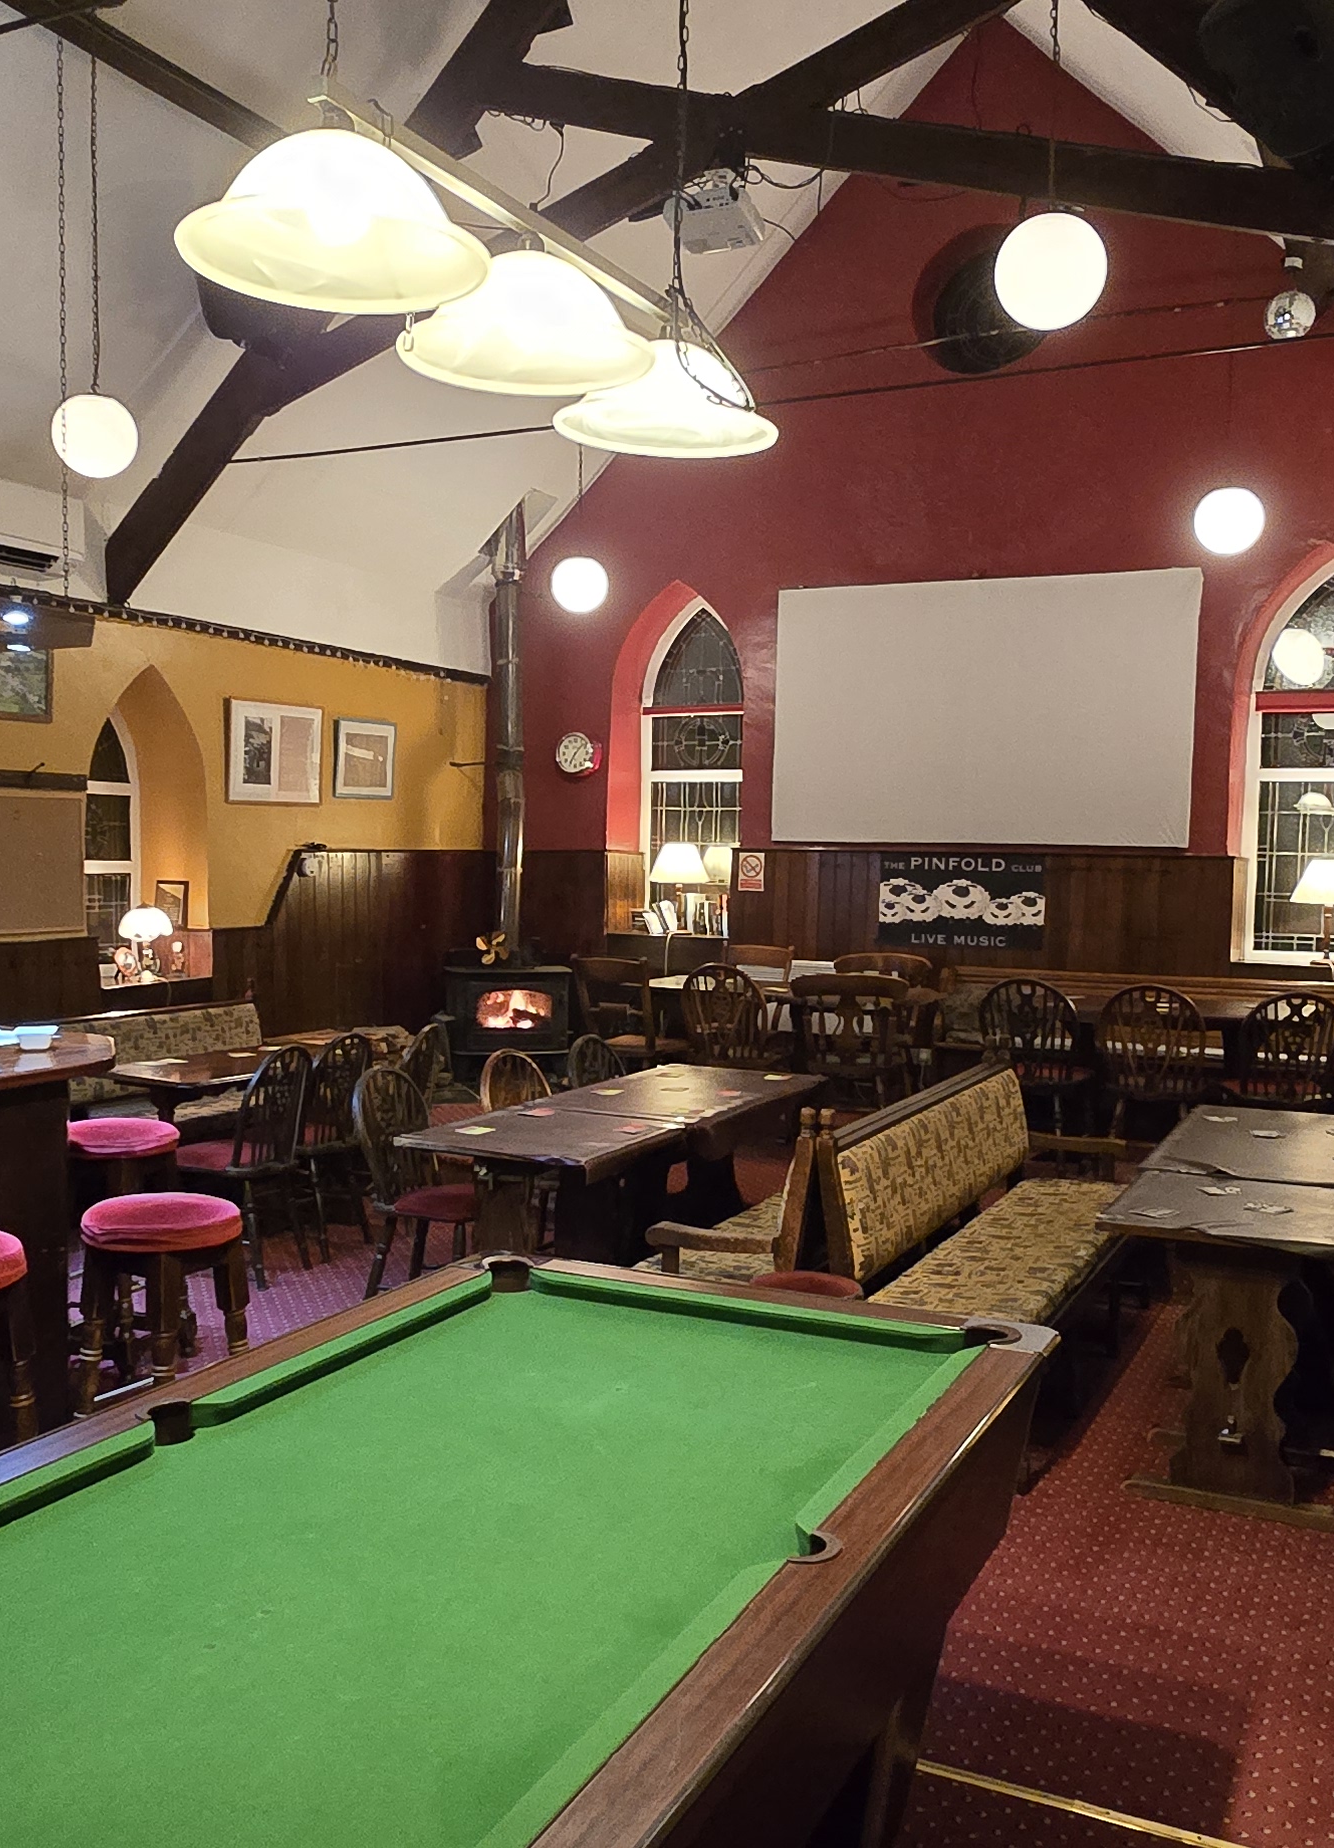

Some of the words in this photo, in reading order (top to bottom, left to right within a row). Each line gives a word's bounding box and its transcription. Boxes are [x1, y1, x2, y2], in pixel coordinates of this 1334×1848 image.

[883, 861, 906, 870] THE
[910, 856, 1006, 873] PINFOLD
[1011, 864, 1043, 873] CLUB
[911, 933, 947, 945] LIVE
[953, 935, 1007, 948] MUSIC
